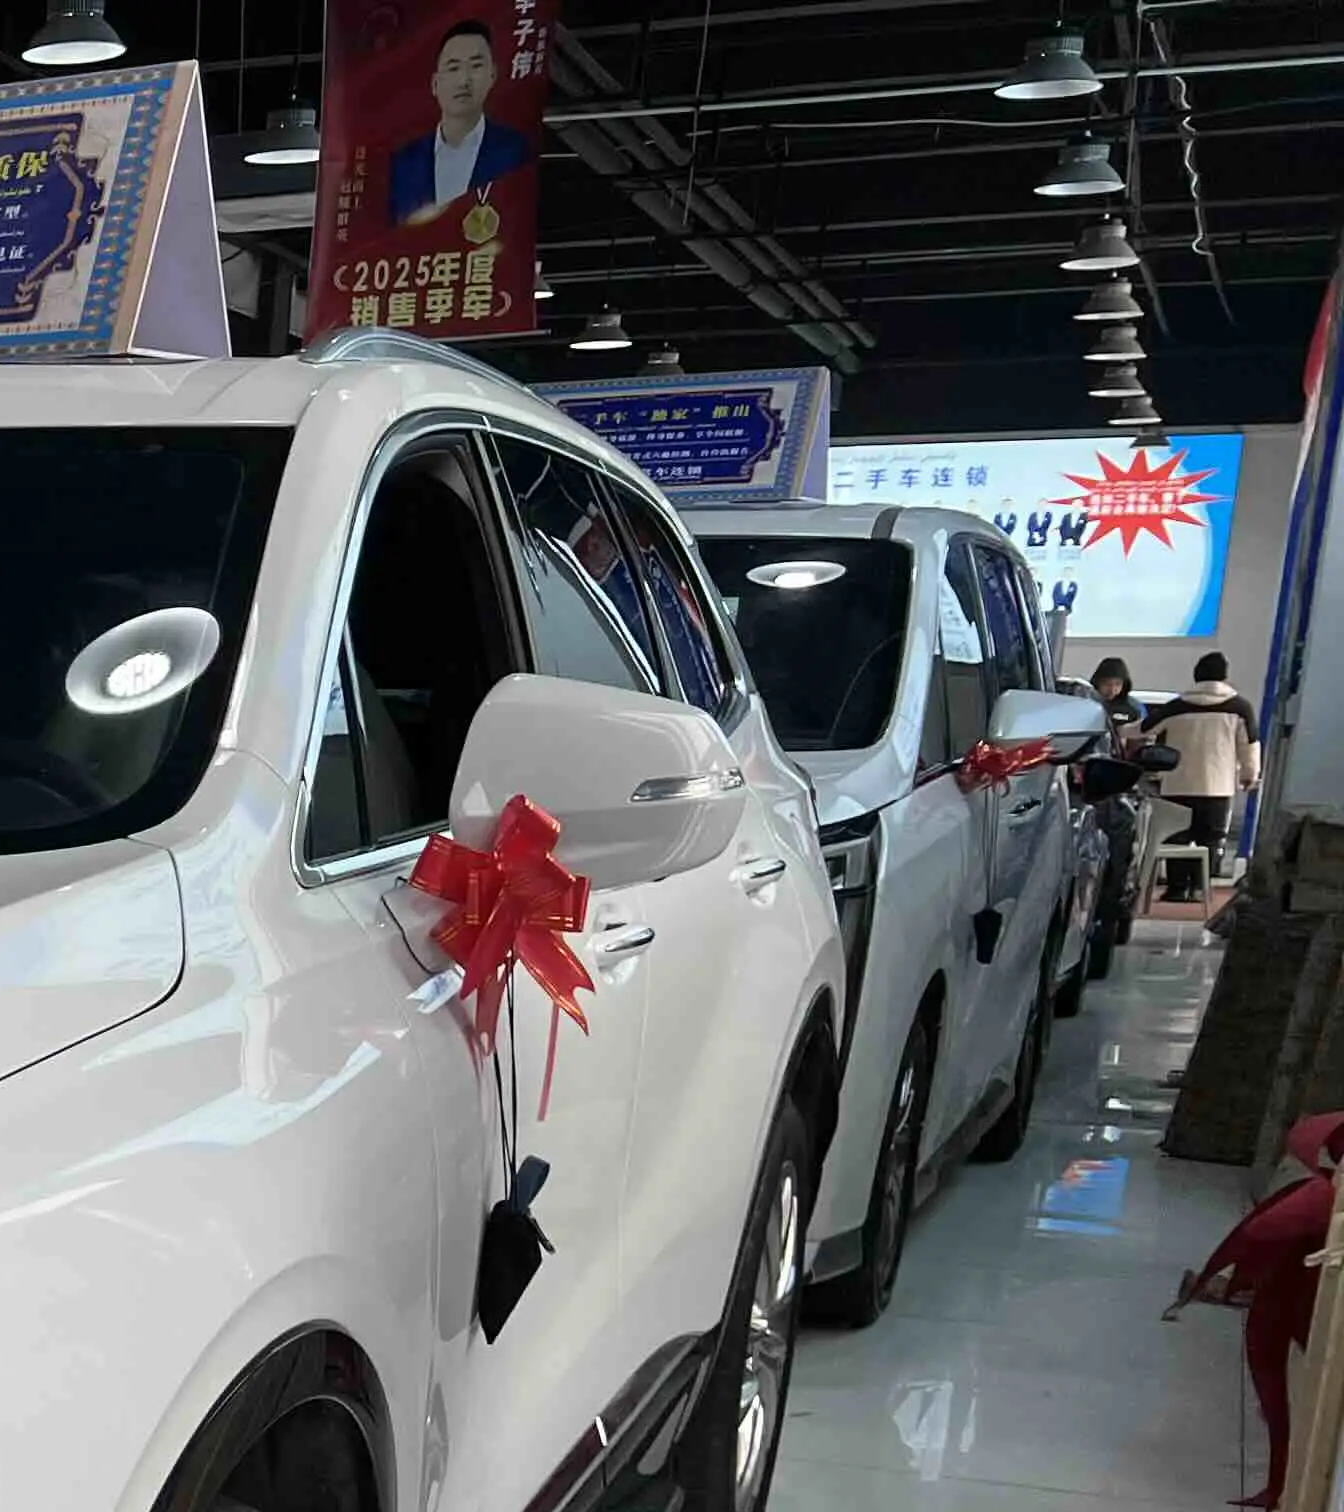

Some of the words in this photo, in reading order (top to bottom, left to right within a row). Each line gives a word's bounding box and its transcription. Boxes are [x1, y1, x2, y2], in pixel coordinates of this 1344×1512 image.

[832, 463, 989, 490] 二手车连锁
